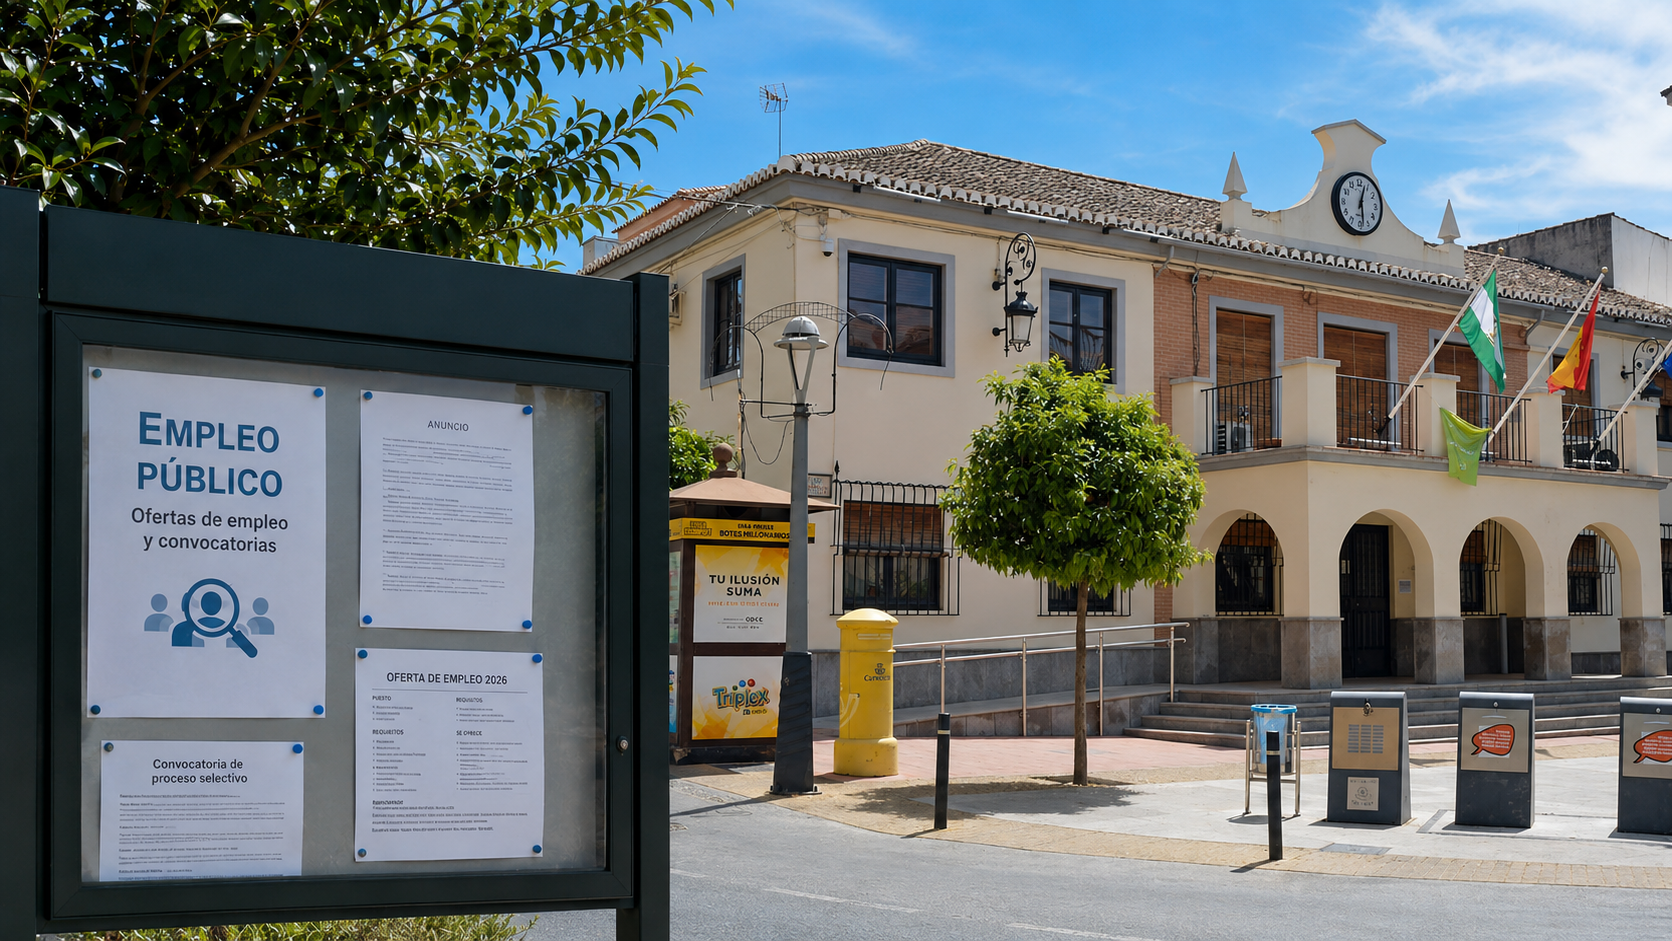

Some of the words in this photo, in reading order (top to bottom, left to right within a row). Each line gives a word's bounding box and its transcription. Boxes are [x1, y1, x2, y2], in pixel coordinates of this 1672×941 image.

[427, 420, 470, 432] ANUNCIO
[137, 456, 284, 498] PÚBLICO
[131, 507, 197, 526] Ofertas
[201, 510, 223, 528] de
[227, 513, 290, 533] empleo
[143, 535, 154, 552] y
[158, 536, 278, 553] convocatorias
[708, 574, 727, 585] TU
[729, 573, 780, 586] ILUSIÓN
[726, 586, 763, 597] SUMA
[386, 671, 426, 684] OFERTA
[427, 673, 442, 684] DE
[443, 673, 484, 685] EMPLEO
[484, 674, 508, 685] 2026
[152, 757, 228, 770] Convocatoria
[229, 758, 244, 770] de
[151, 774, 197, 786] proceso
[199, 772, 249, 784] selectivo
